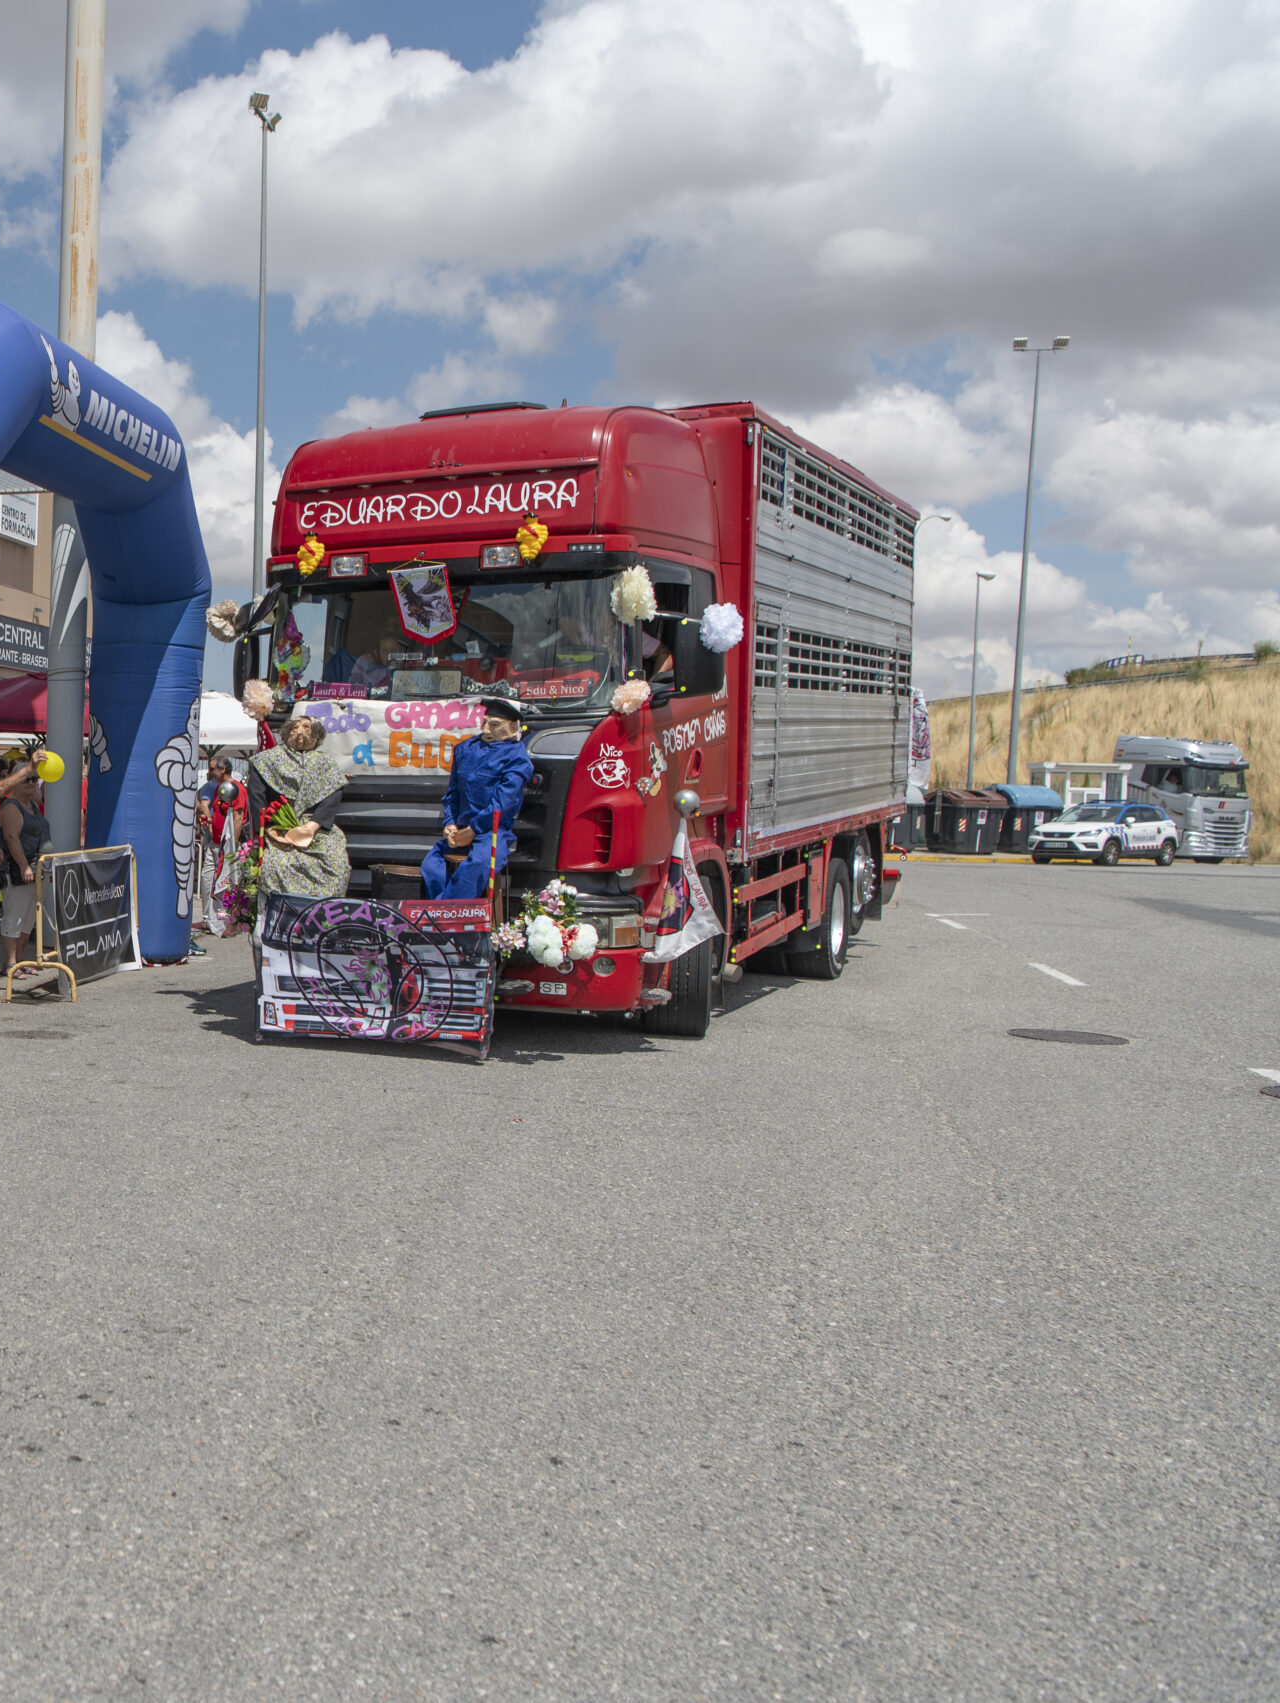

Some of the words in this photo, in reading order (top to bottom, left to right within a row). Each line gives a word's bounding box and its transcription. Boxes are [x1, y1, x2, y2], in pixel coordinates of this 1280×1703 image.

[84, 389, 181, 472] MICHELIN
[1, 504, 20, 520] CENTRO
[20, 511, 27, 523] DE
[300, 490, 462, 529] EDUARDO
[466, 478, 579, 514] LAURA
[0, 517, 36, 540] FORMACIÓN
[22, 652, 48, 669] BRASERI
[313, 685, 337, 696] Laura
[526, 686, 546, 696] Edu
[549, 685, 558, 695] &
[560, 684, 585, 694] Nico
[384, 699, 487, 731] GRACIA
[600, 743, 623, 757] Nico
[84, 884, 125, 905] Mercedes-Benz
[691, 882, 708, 911] LAURA
[305, 900, 409, 938] TEAM
[457, 908, 486, 918] LAURA
[66, 929, 123, 962] POLAINA
